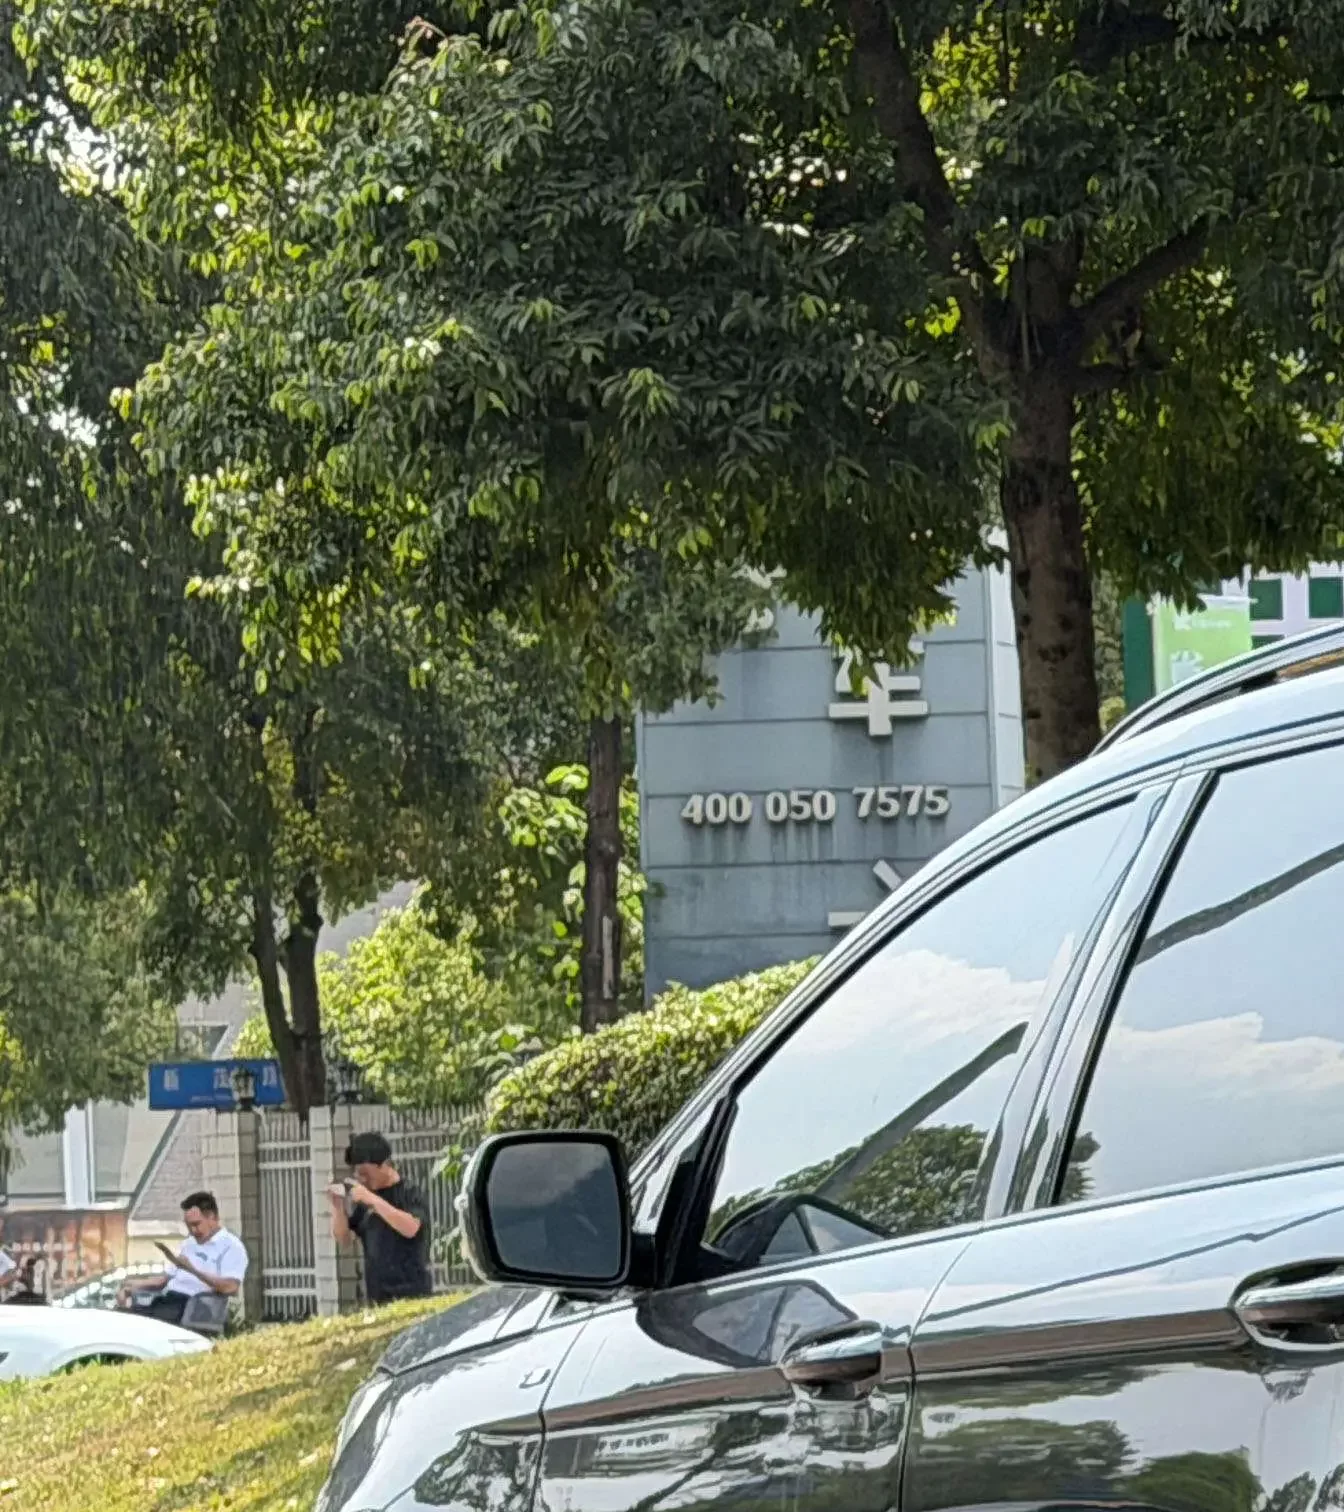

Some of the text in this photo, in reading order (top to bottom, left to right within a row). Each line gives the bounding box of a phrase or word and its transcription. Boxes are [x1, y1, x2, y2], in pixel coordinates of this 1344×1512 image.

[682, 786, 950, 824] 400 050 7575
